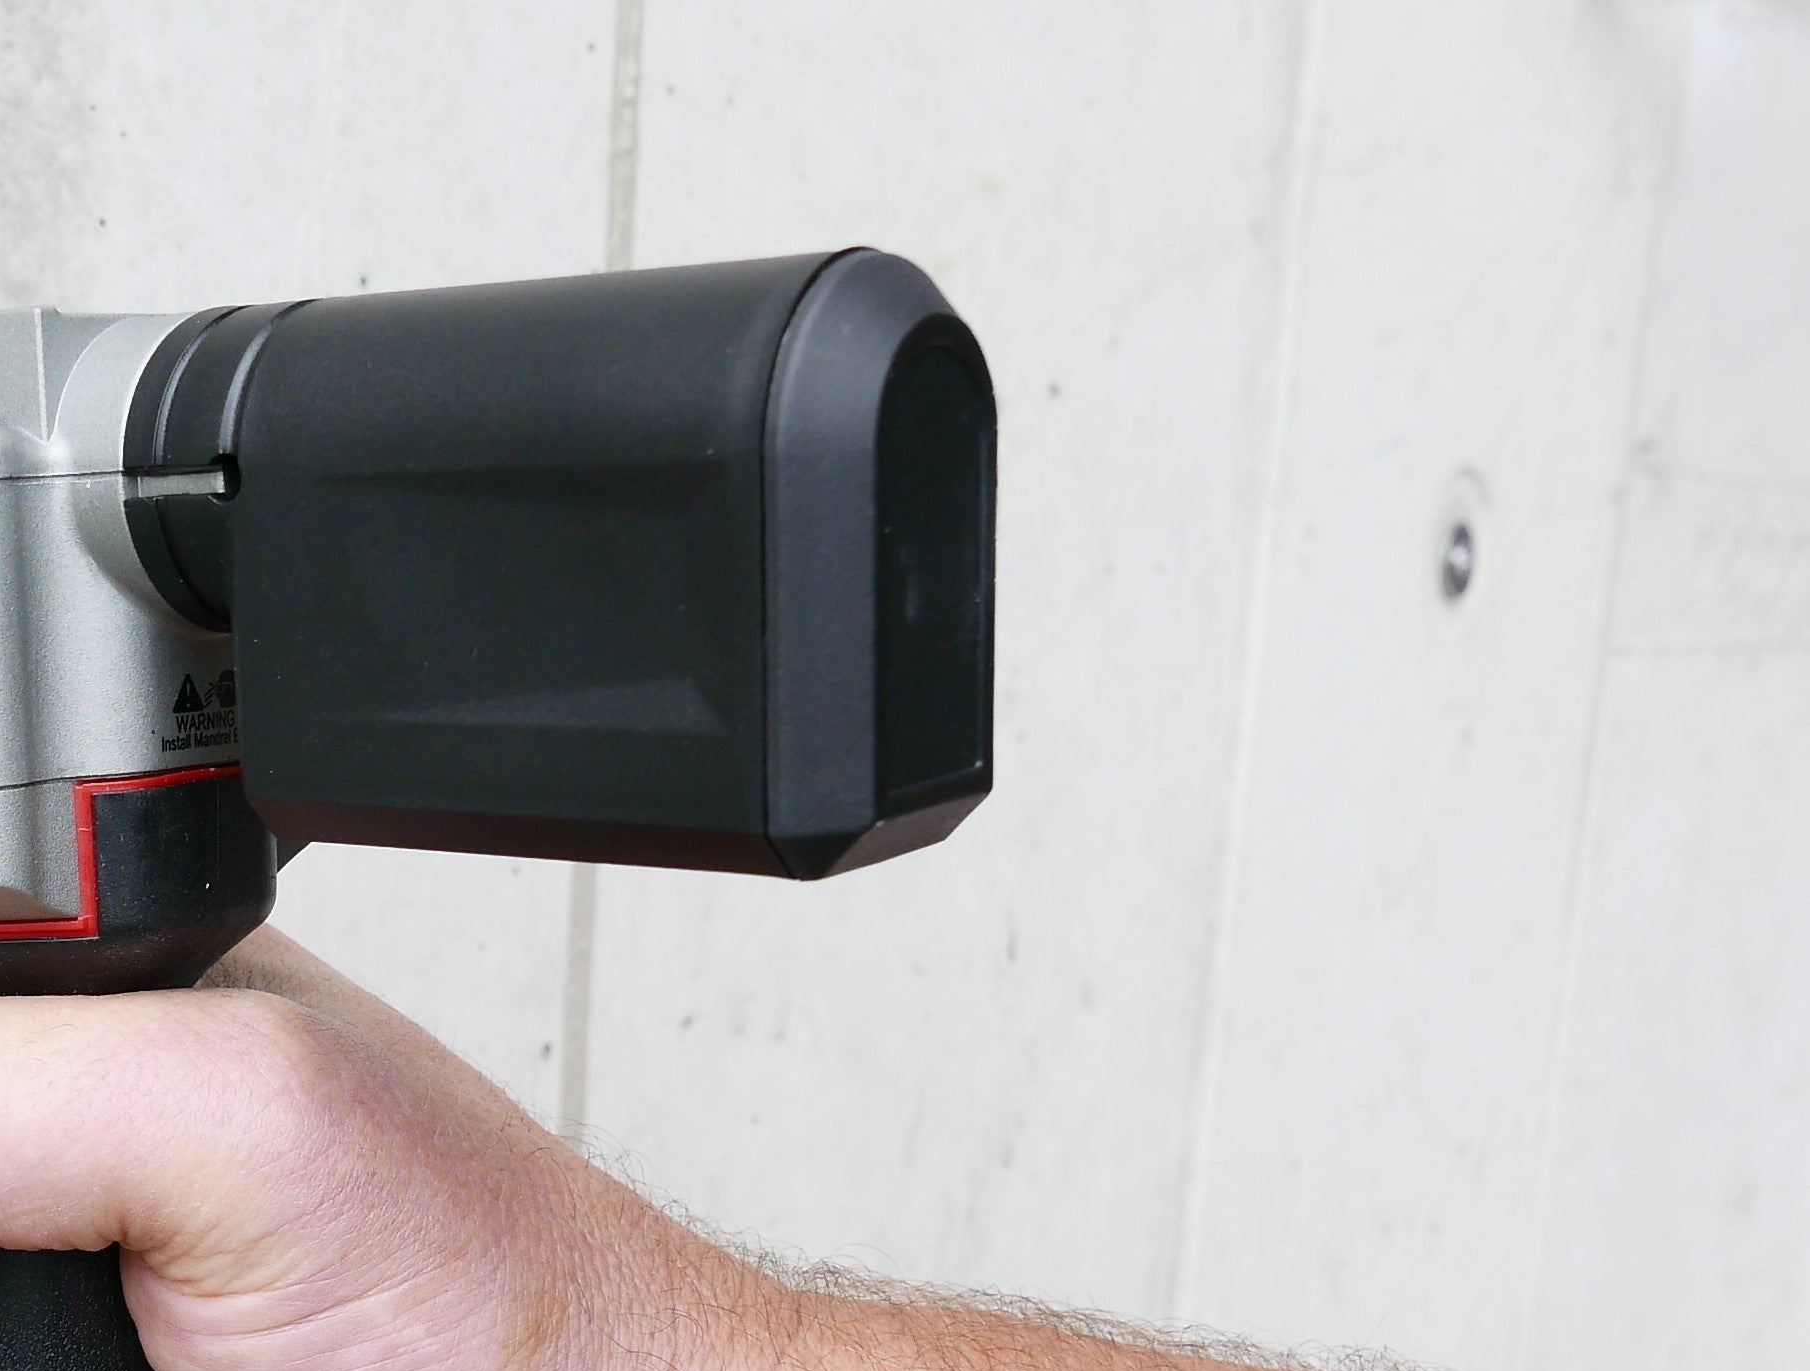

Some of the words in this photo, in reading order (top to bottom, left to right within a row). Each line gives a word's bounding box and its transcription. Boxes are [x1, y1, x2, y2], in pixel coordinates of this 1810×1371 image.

[175, 709, 235, 733] WARNING
[161, 733, 191, 752] Install
[194, 730, 232, 748] Mandrel
